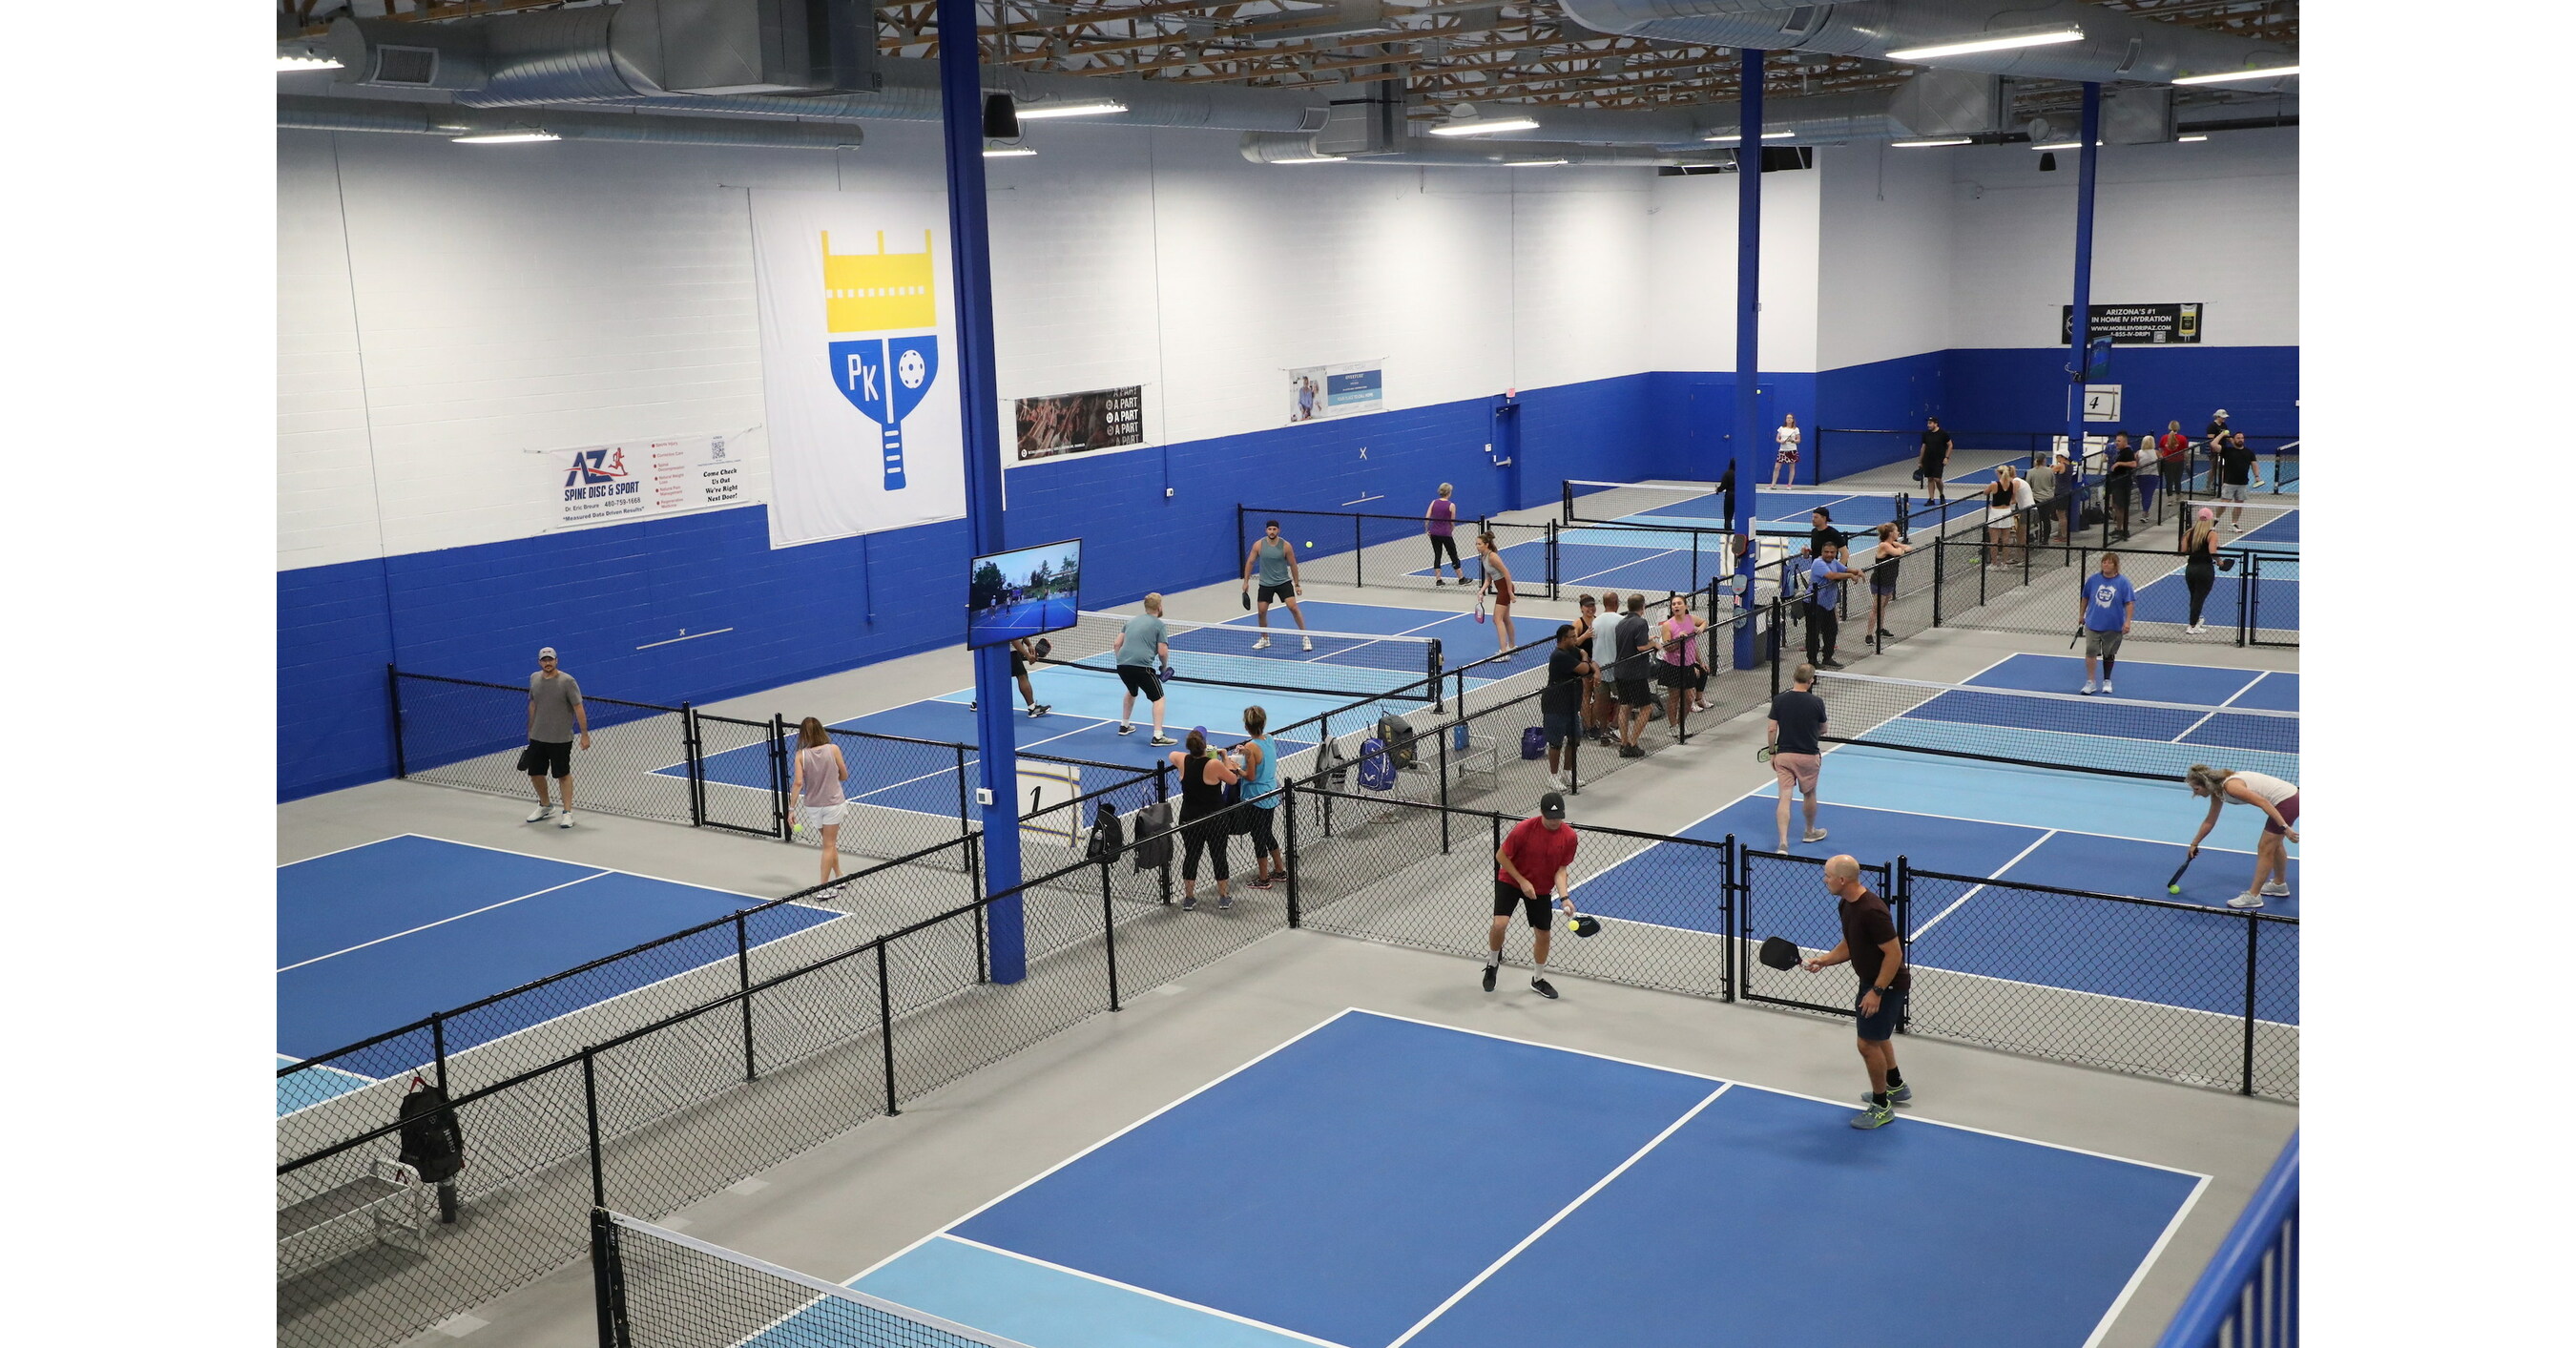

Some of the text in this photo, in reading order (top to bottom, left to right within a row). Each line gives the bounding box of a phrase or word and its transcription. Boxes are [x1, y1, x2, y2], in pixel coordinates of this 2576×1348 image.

[1114, 397, 1138, 409] A PART
[2089, 396, 2100, 409] 4
[1114, 409, 1139, 423] A PART
[1115, 422, 1139, 435] A PART
[565, 450, 613, 487] AZ
[565, 481, 640, 501] SPINE DISC & SPORT
[605, 497, 641, 507] 480-759-1668
